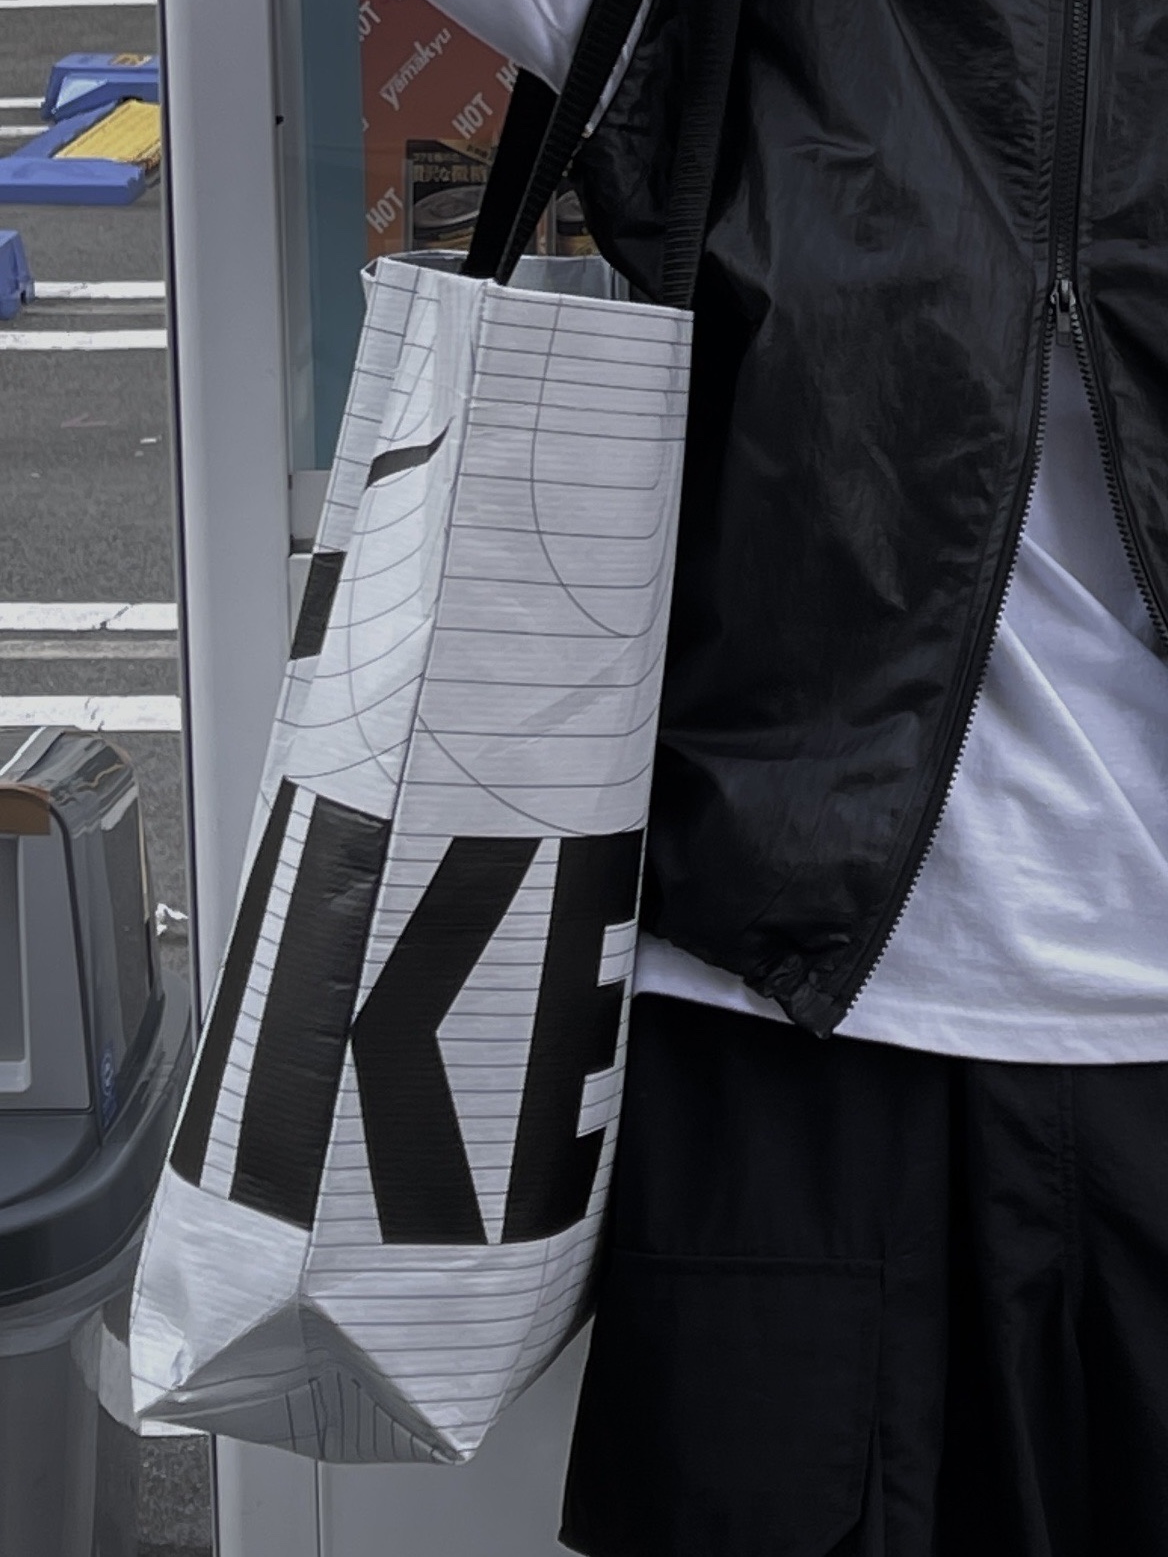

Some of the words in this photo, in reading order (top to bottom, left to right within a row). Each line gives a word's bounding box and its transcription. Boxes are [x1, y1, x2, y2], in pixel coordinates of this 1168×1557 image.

[379, 28, 452, 110] yamakyu
[452, 92, 493, 140] HOT
[366, 187, 404, 233] HOT
